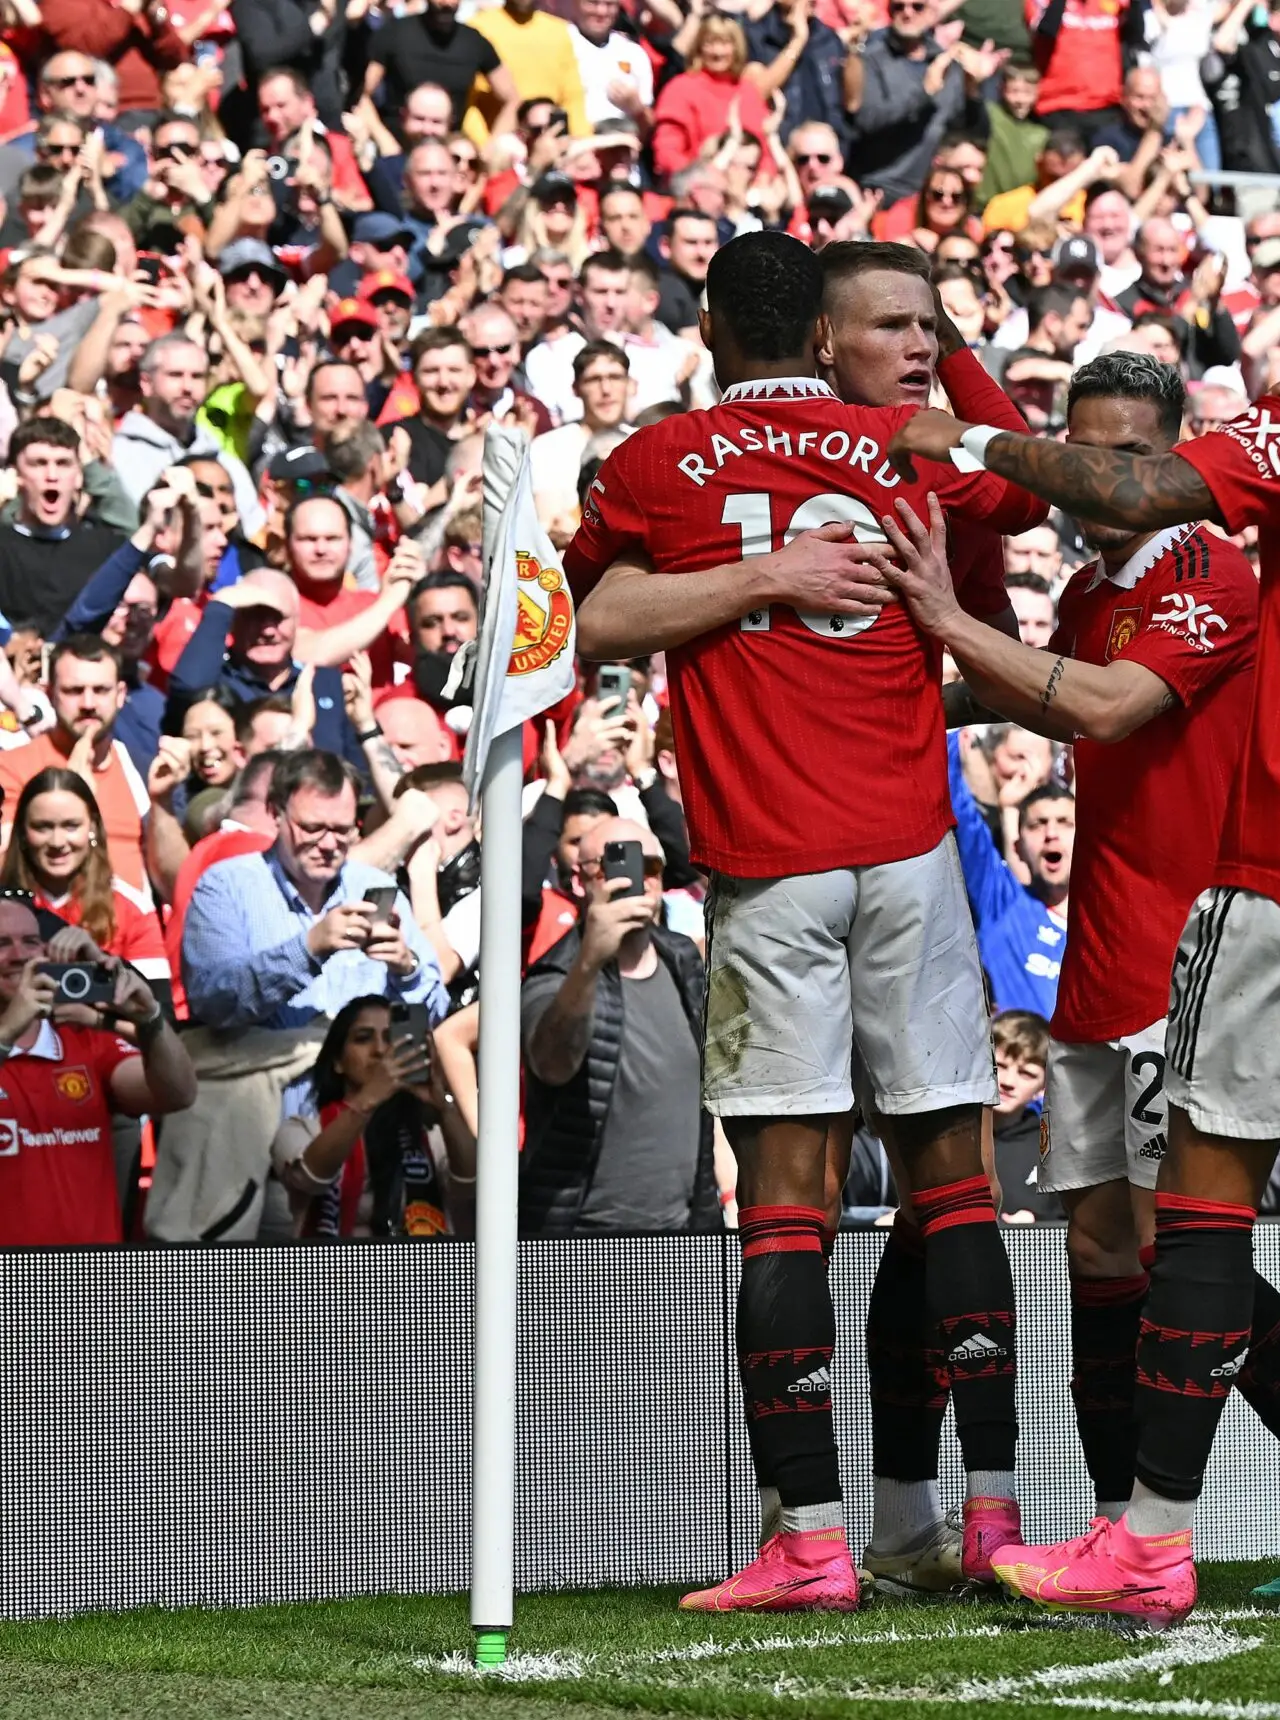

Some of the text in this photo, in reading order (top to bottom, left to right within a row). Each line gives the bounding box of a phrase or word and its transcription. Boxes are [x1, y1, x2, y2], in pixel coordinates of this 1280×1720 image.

[720, 492, 889, 638] 10
[514, 613, 568, 671] UNITED
[1152, 593, 1229, 649] DXC
[947, 1346, 1008, 1362] adidas
